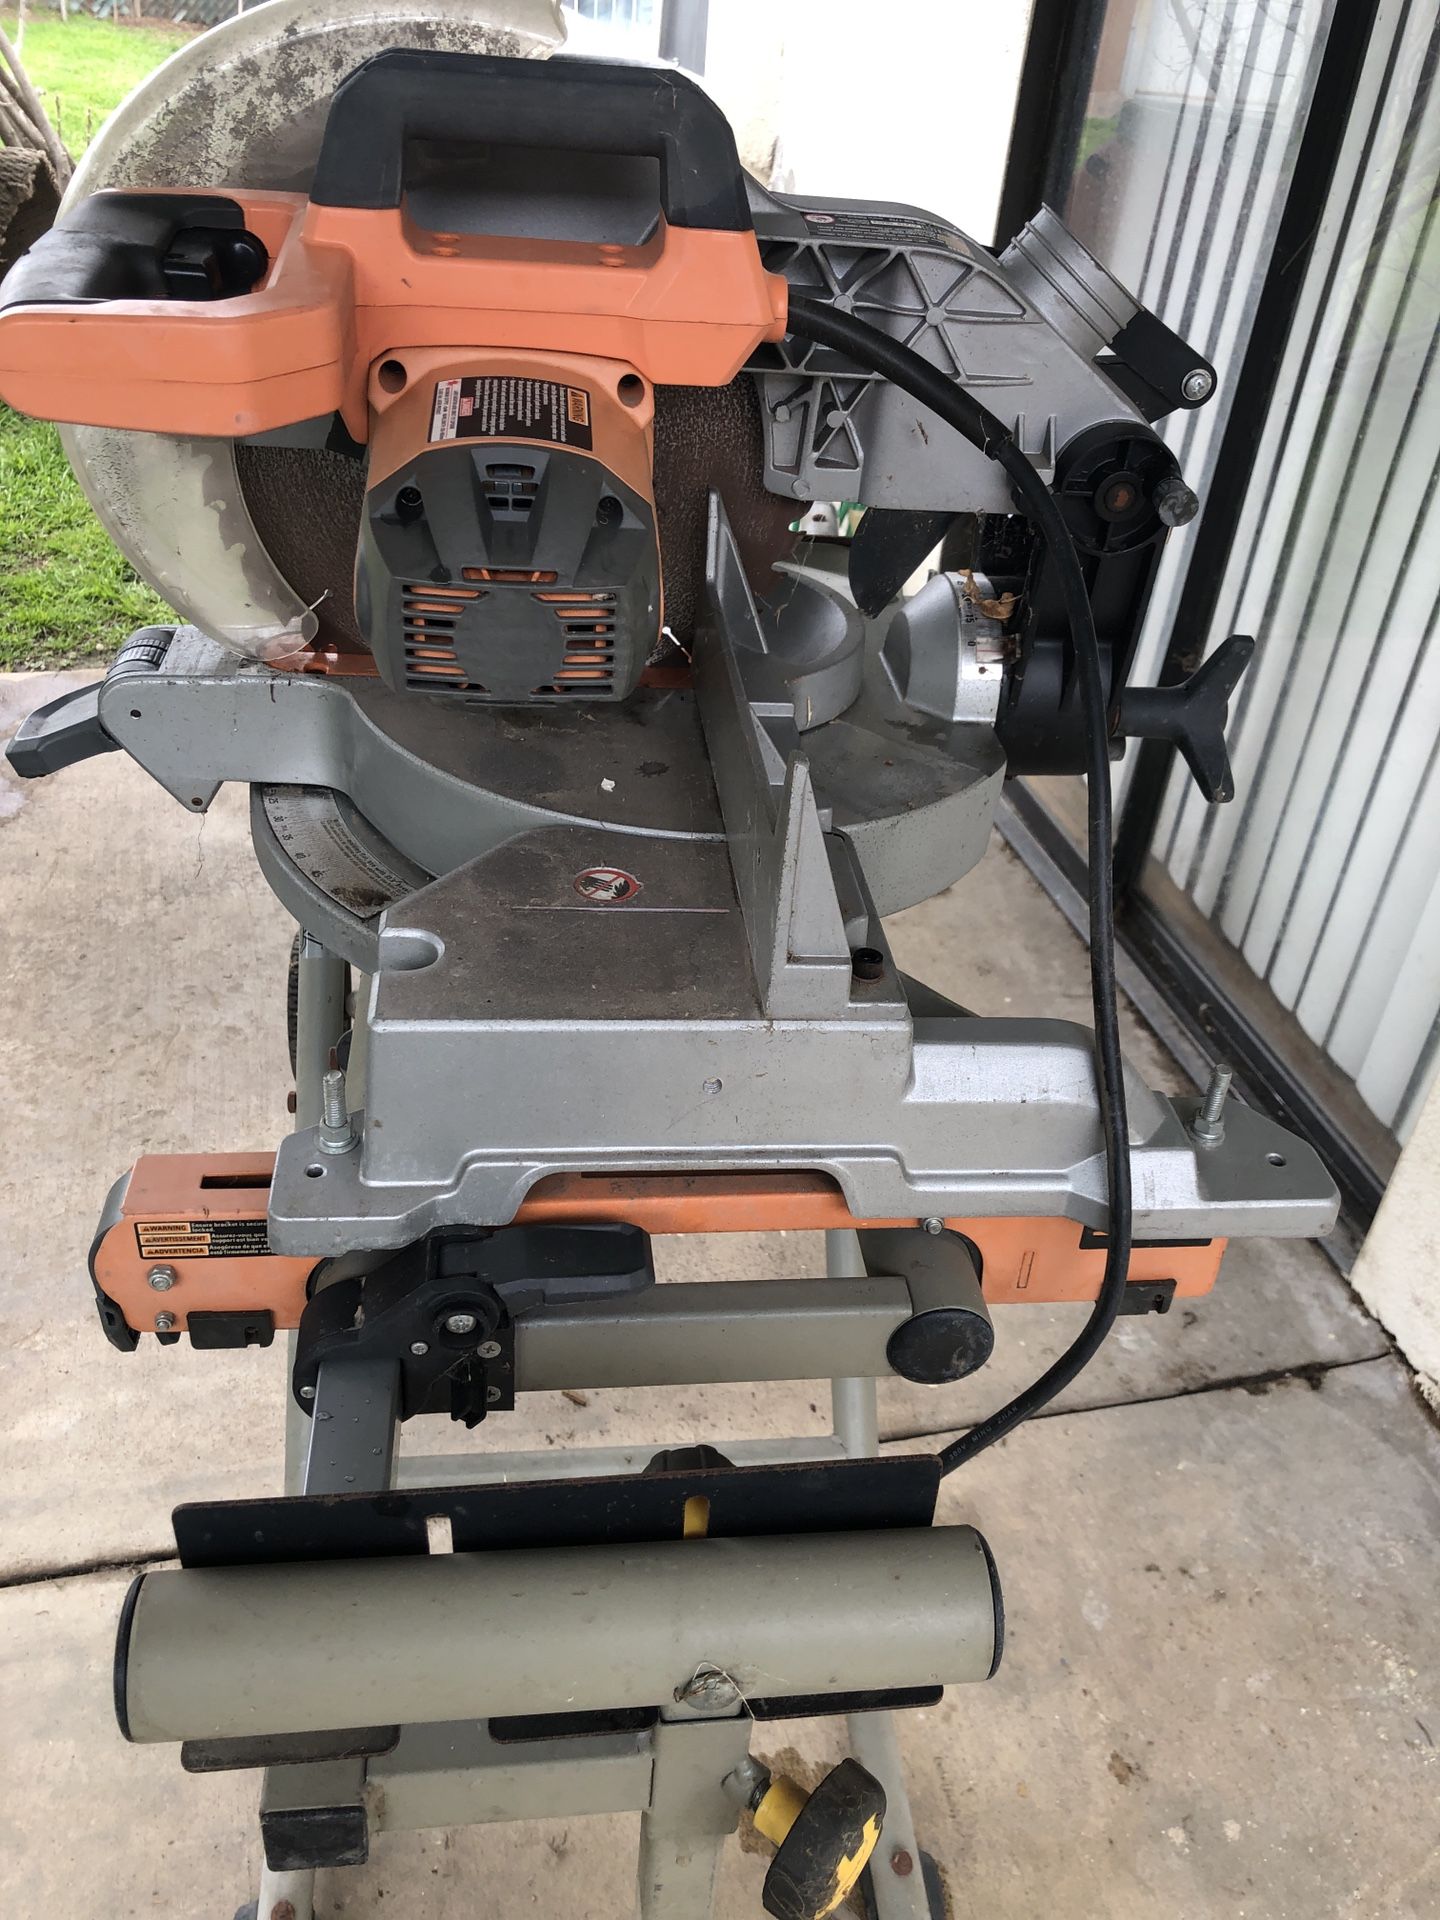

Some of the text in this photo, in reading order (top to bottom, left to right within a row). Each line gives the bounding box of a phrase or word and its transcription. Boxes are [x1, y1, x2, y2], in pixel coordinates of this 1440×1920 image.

[965, 614, 975, 623] 15
[149, 1224, 187, 1232] WARNING
[152, 1235, 206, 1243] AVERTISSEMENT
[154, 1247, 204, 1255] ADVERTENCIA
